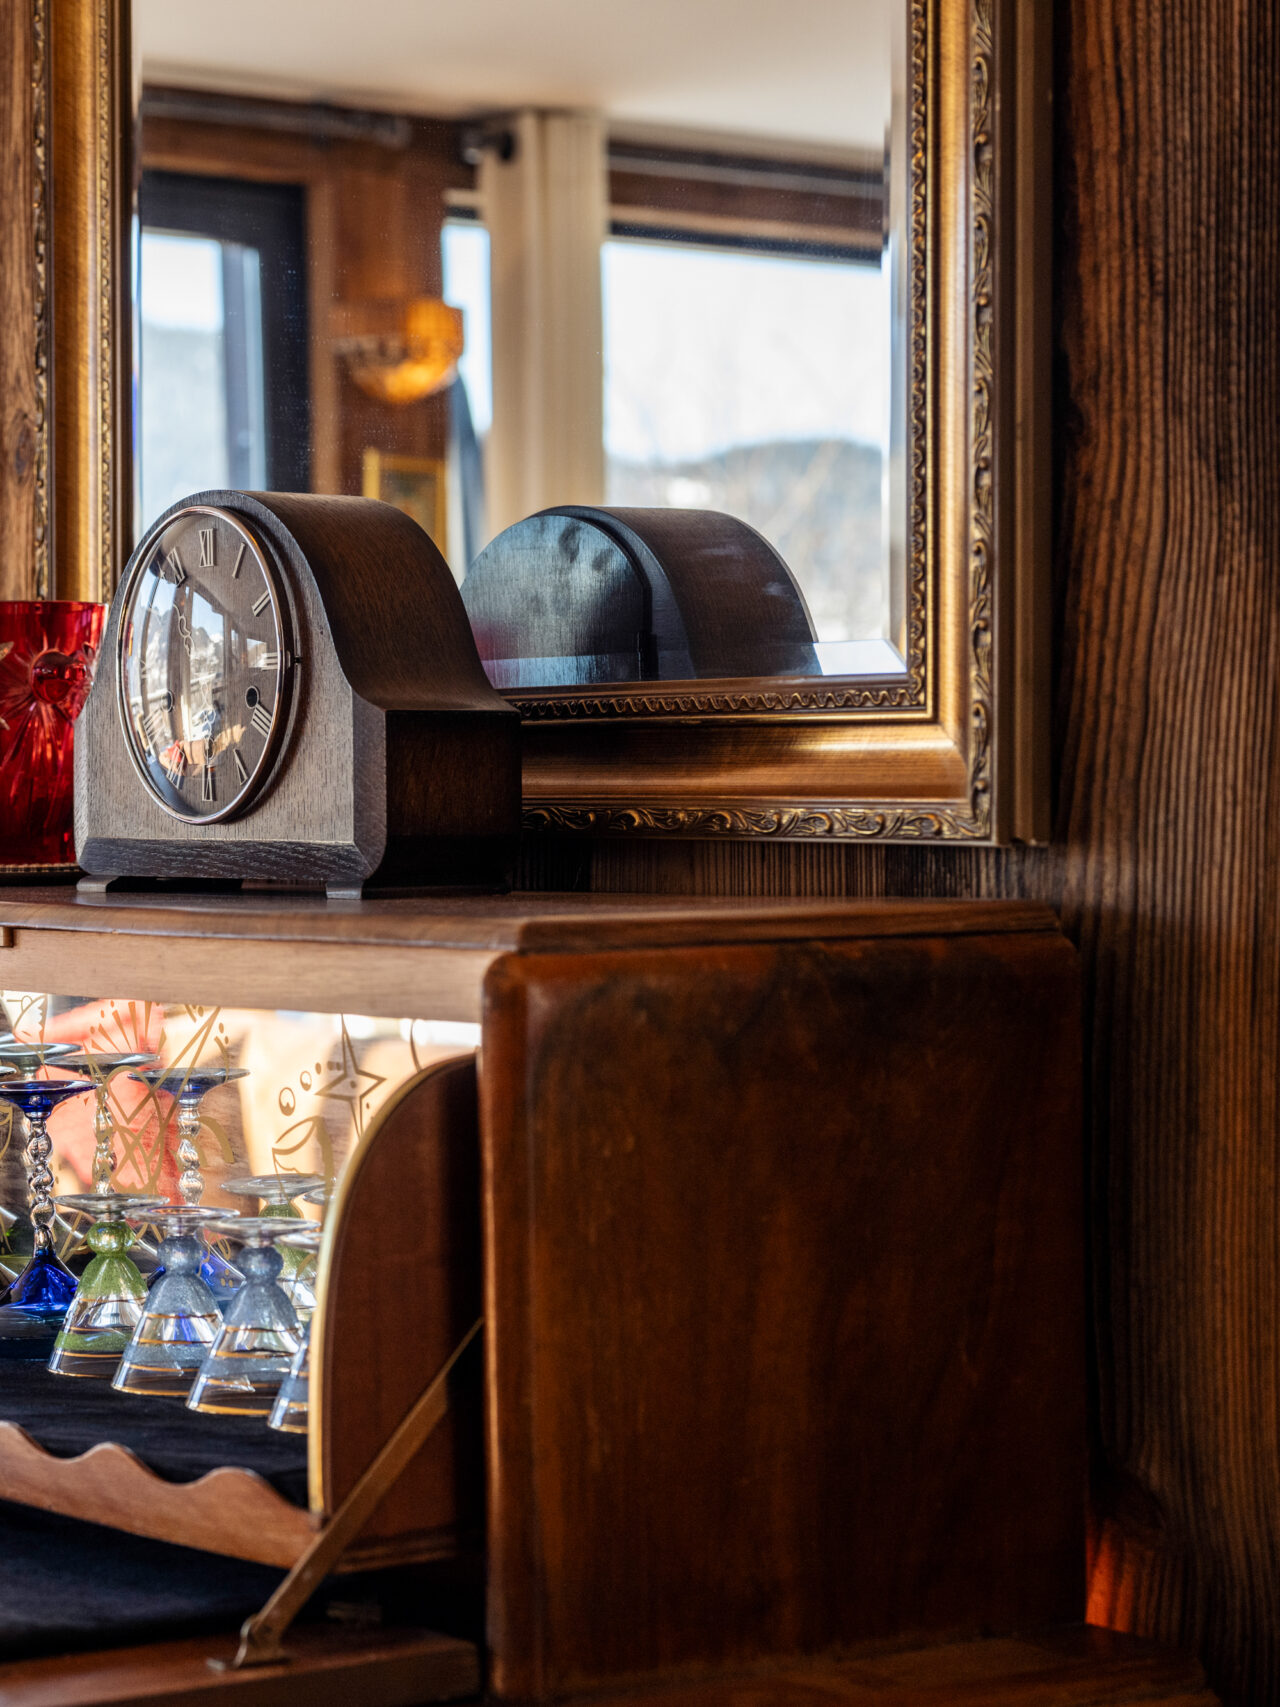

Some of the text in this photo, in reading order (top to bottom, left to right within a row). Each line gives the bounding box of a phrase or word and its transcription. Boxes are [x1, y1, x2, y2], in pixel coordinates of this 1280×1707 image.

[166, 546, 186, 588] XI
[198, 528, 214, 568] XII
[251, 589, 272, 617] II
[261, 651, 278, 671] III
[250, 704, 273, 739] IIII
[201, 764, 214, 802] VI
[233, 748, 249, 786] V
